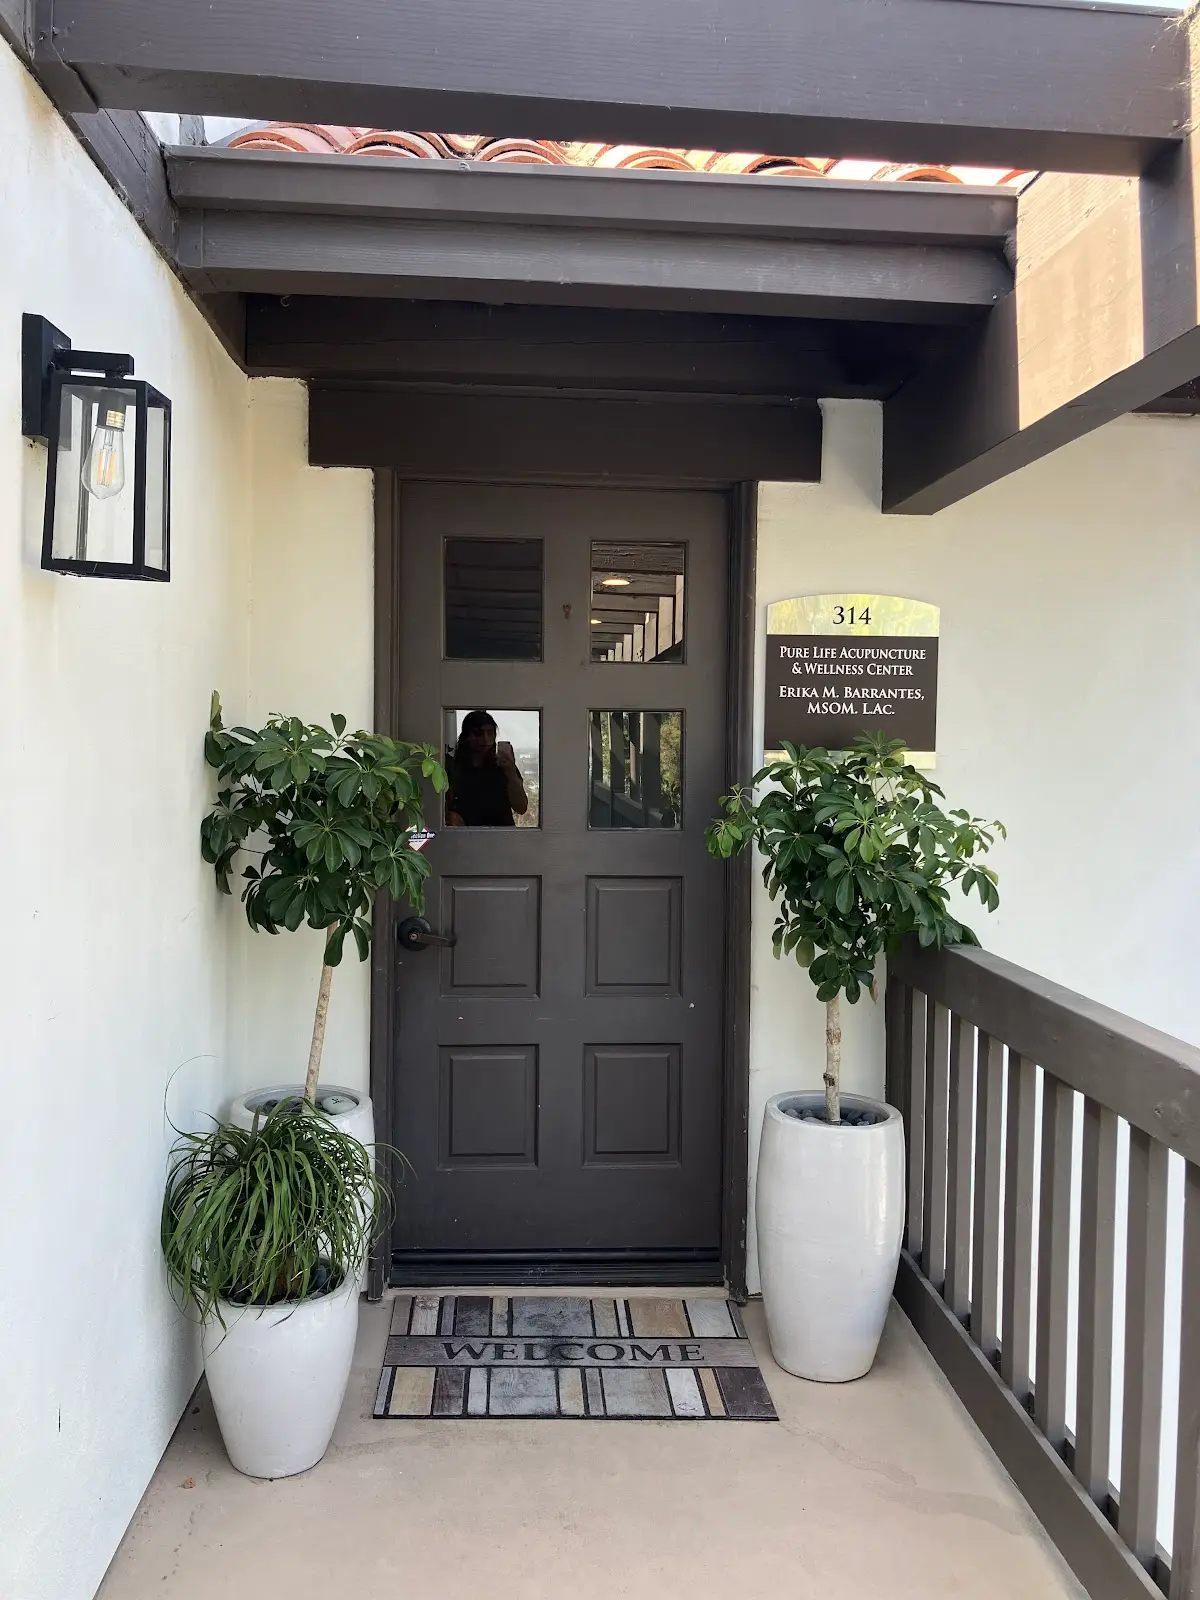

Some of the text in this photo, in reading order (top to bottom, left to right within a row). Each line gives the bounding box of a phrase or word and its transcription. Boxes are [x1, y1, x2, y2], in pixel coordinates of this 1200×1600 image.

[833, 606, 872, 625] 314
[779, 645, 927, 660] PURE LIFE ACUPUNCTURE
[791, 662, 914, 676] & WELLNESS CENTER
[779, 685, 925, 700] ERIKA M. BARRANTES,
[806, 702, 858, 715] MSOM.
[441, 1342, 705, 1361] WELCOME
